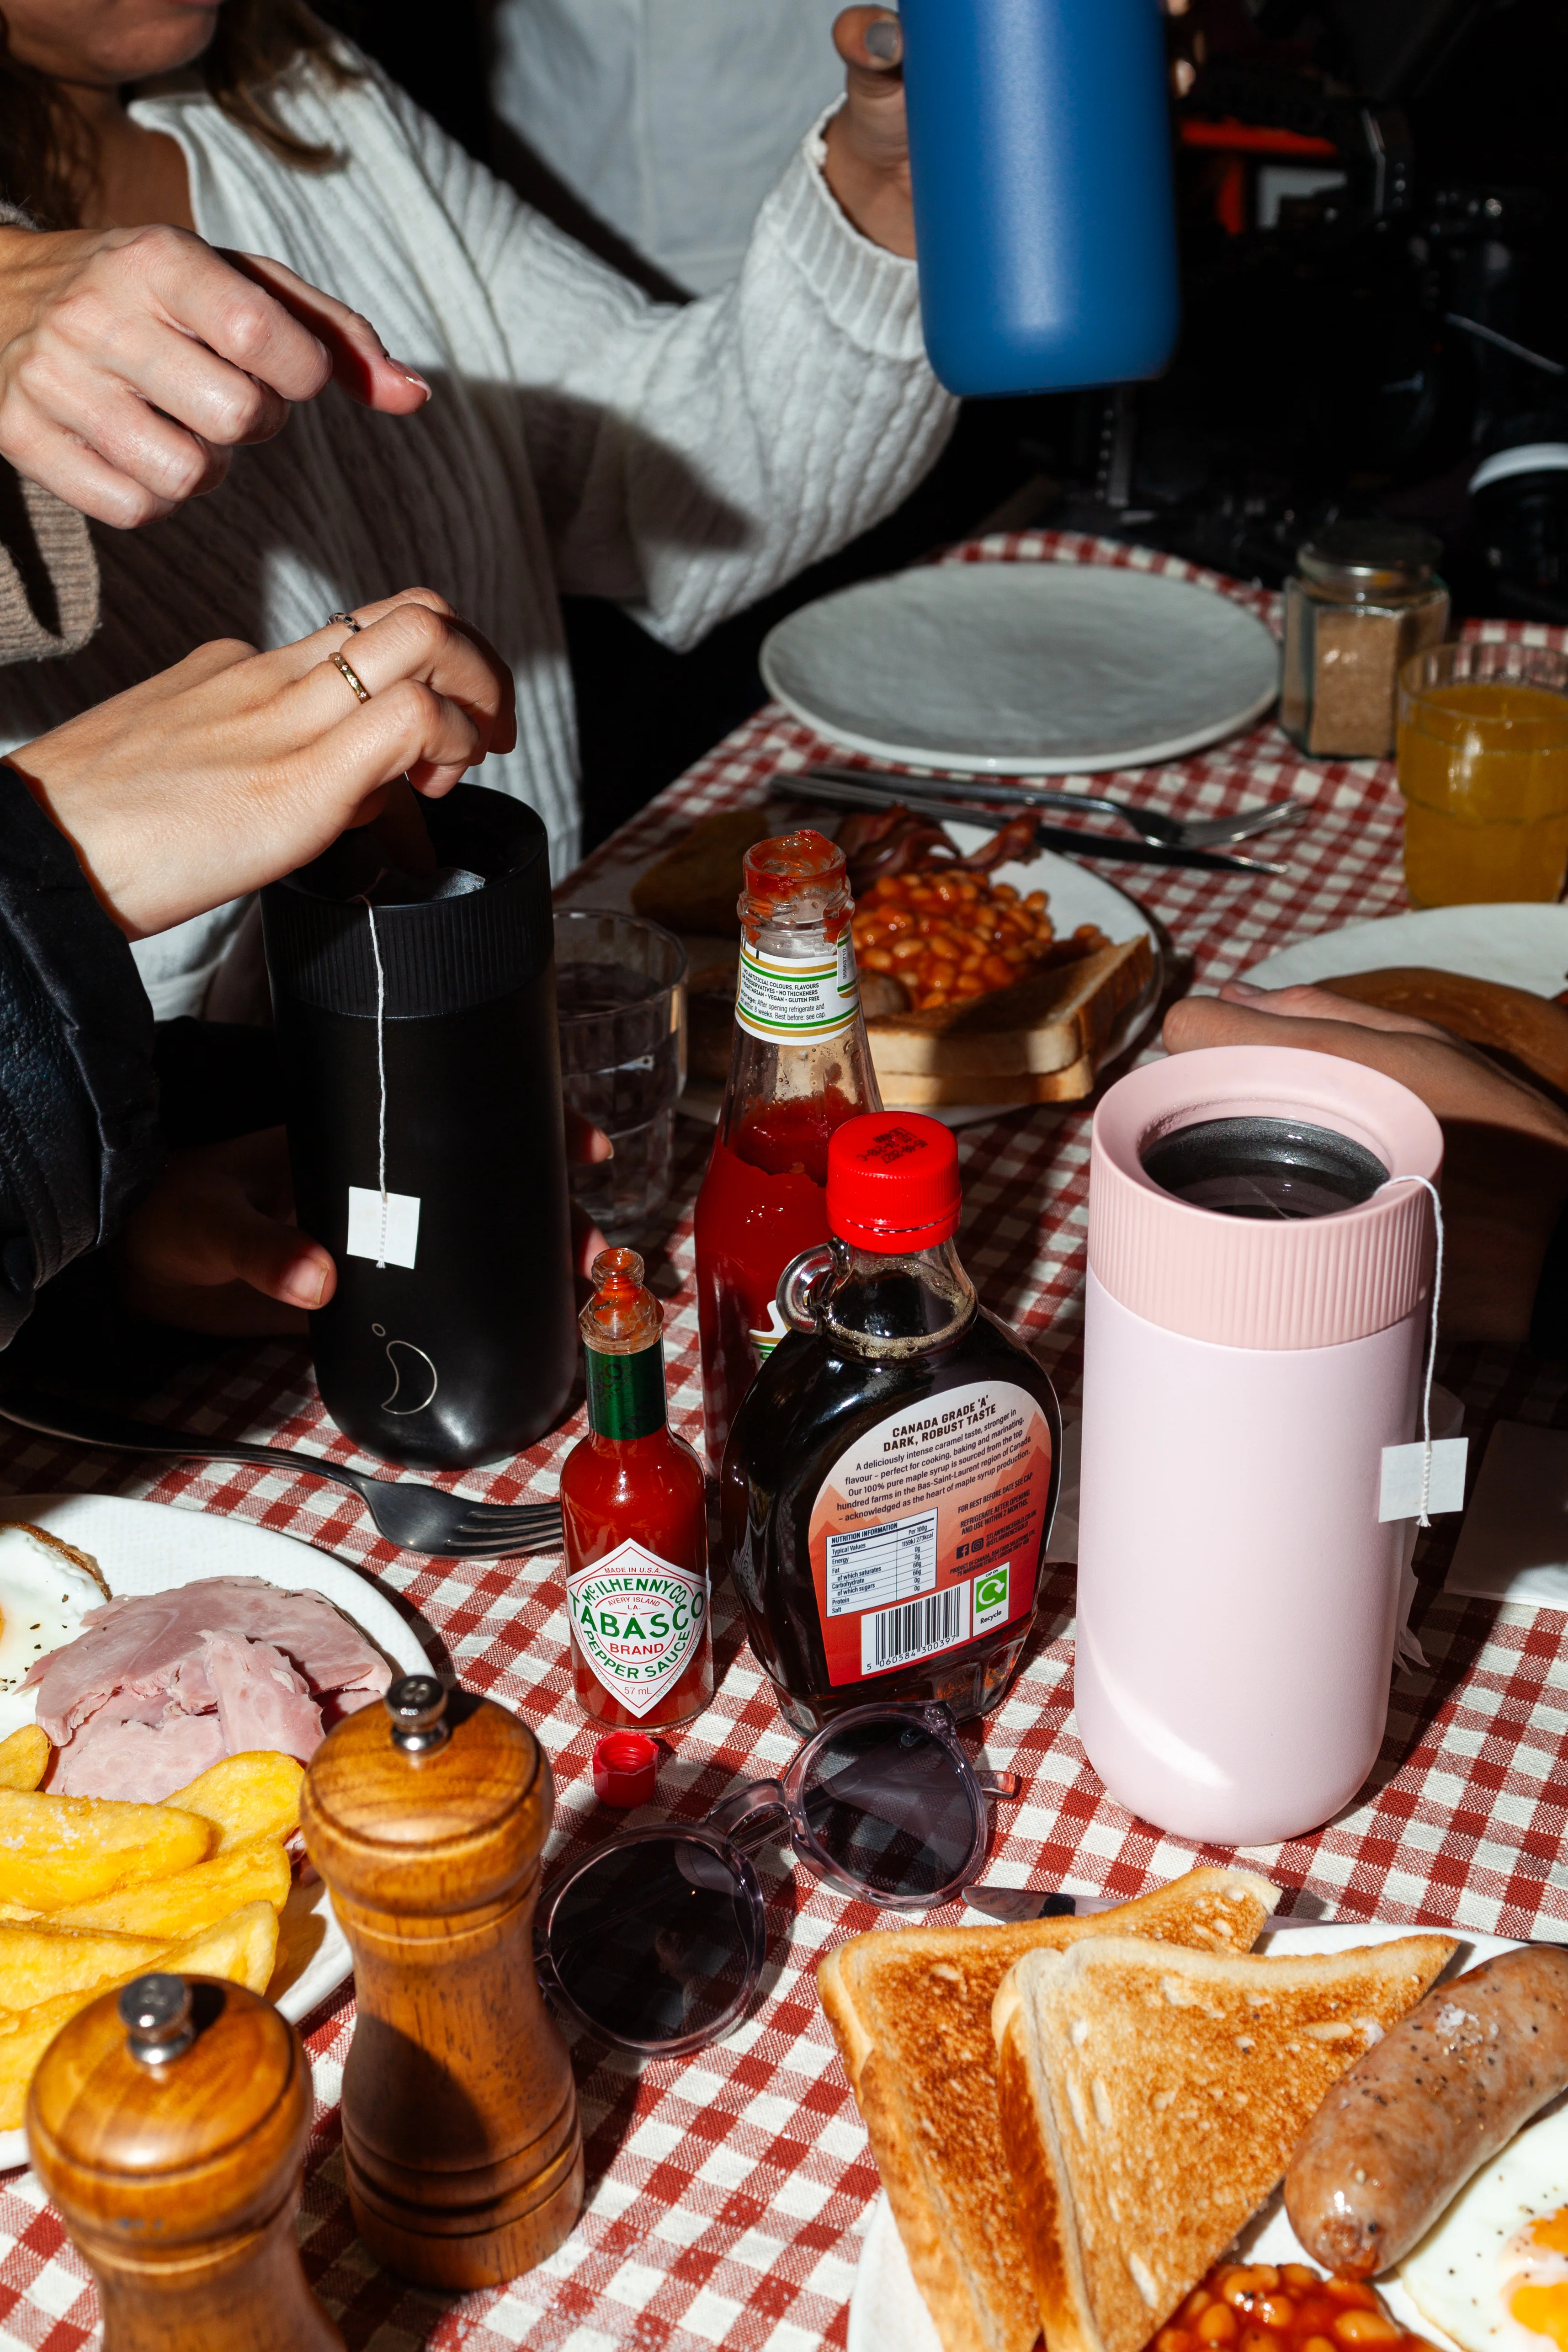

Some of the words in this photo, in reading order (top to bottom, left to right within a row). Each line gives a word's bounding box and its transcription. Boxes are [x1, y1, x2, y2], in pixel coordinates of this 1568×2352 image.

[744, 981, 764, 997] VEGETARIAN
[746, 976, 775, 994] PRESERVATIVES
[748, 973, 769, 986] ARTIFICIAL
[770, 982, 793, 990] COLOURS,
[741, 989, 756, 1004] storage:
[757, 999, 767, 1008] After
[769, 1004, 787, 1013] opening
[789, 1005, 814, 1014] refrigerate
[744, 1001, 753, 1011] within
[758, 1009, 773, 1018] weeks.
[883, 1436, 918, 1452] DARK,
[922, 1419, 963, 1442] ROBUST
[967, 1404, 996, 1425] TASTE
[893, 1417, 938, 1437] CANADA
[941, 1402, 975, 1423] GRADE
[978, 1394, 988, 1408] 'A'
[845, 1474, 872, 1485] flavour
[881, 1465, 908, 1479] perfect
[921, 1453, 951, 1467] cooking,
[953, 1442, 976, 1456] baking
[978, 1434, 989, 1446] and
[991, 1417, 1024, 1439] marinating.
[863, 1454, 904, 1469] deliciously
[906, 1447, 933, 1459] intense
[935, 1434, 962, 1451] caramel
[965, 1428, 983, 1440] taste,
[984, 1413, 1010, 1431] stronger
[837, 1497, 869, 1511] hundred
[871, 1493, 893, 1503] farms
[904, 1487, 915, 1495] the
[917, 1462, 979, 1491] Bas-Saint-Laurent
[981, 1453, 1001, 1467] region
[1002, 1447, 1008, 1457] of
[1010, 1436, 1031, 1453] Canada
[864, 1483, 884, 1493] 100%
[887, 1479, 904, 1490] pure
[905, 1471, 928, 1483] maple
[930, 1464, 949, 1476] syrup
[958, 1447, 985, 1465] sourced
[987, 1442, 1001, 1453] from
[1003, 1436, 1012, 1445] the
[1013, 1429, 1022, 1439] top
[845, 1501, 900, 1521] acknowledged
[913, 1495, 924, 1504] the
[926, 1487, 945, 1499] heart
[946, 1483, 953, 1492] of
[955, 1476, 975, 1489] maple
[977, 1468, 995, 1480] syrup
[996, 1449, 1030, 1473] production.
[958, 1503, 968, 1513] FOR
[969, 1498, 982, 1509] BEST
[983, 1489, 1001, 1503] BEFORE
[1002, 1482, 1014, 1494] DATE
[1015, 1477, 1023, 1488] SEE
[1023, 1472, 1033, 1483] CAP
[960, 1508, 993, 1527] REFRIGERATE
[994, 1501, 1009, 1513] AFTER
[1010, 1490, 1030, 1505] OPENING
[962, 1525, 973, 1535] AND
[974, 1520, 983, 1530] USE
[984, 1511, 1002, 1525] WITHIN
[1007, 1499, 1028, 1514] MONTHS.
[831, 1532, 860, 1543] NUTRITION
[861, 1522, 898, 1537] INFORMATION
[902, 1538, 915, 1547] 1159kJ
[916, 1532, 933, 1543] 273kcal
[986, 1521, 1028, 1547] @STLAWRENCEGOLD
[832, 1546, 849, 1556] Typical
[832, 1578, 864, 1589] Carbohydrate
[843, 1572, 858, 1580] which
[859, 1567, 881, 1576] saturates
[669, 1585, 686, 1605] CO.
[859, 1583, 875, 1592] sugars
[569, 1589, 704, 1639] TABASCO
[608, 1597, 630, 1606] AVERY
[633, 1597, 660, 1607] ISLAND
[980, 1610, 1001, 1624] Recycle
[583, 1630, 639, 1679] PEPPER
[645, 1631, 690, 1677] SAUCE
[610, 1643, 664, 1655] BRAND
[879, 1650, 915, 1667] 060584
[921, 1634, 956, 1654] 300397
[590, 1660, 614, 1691] VINEGAR
[656, 1686, 668, 1698] RED
[669, 1659, 688, 1684] PEPPER
[688, 1641, 697, 1656] AND
